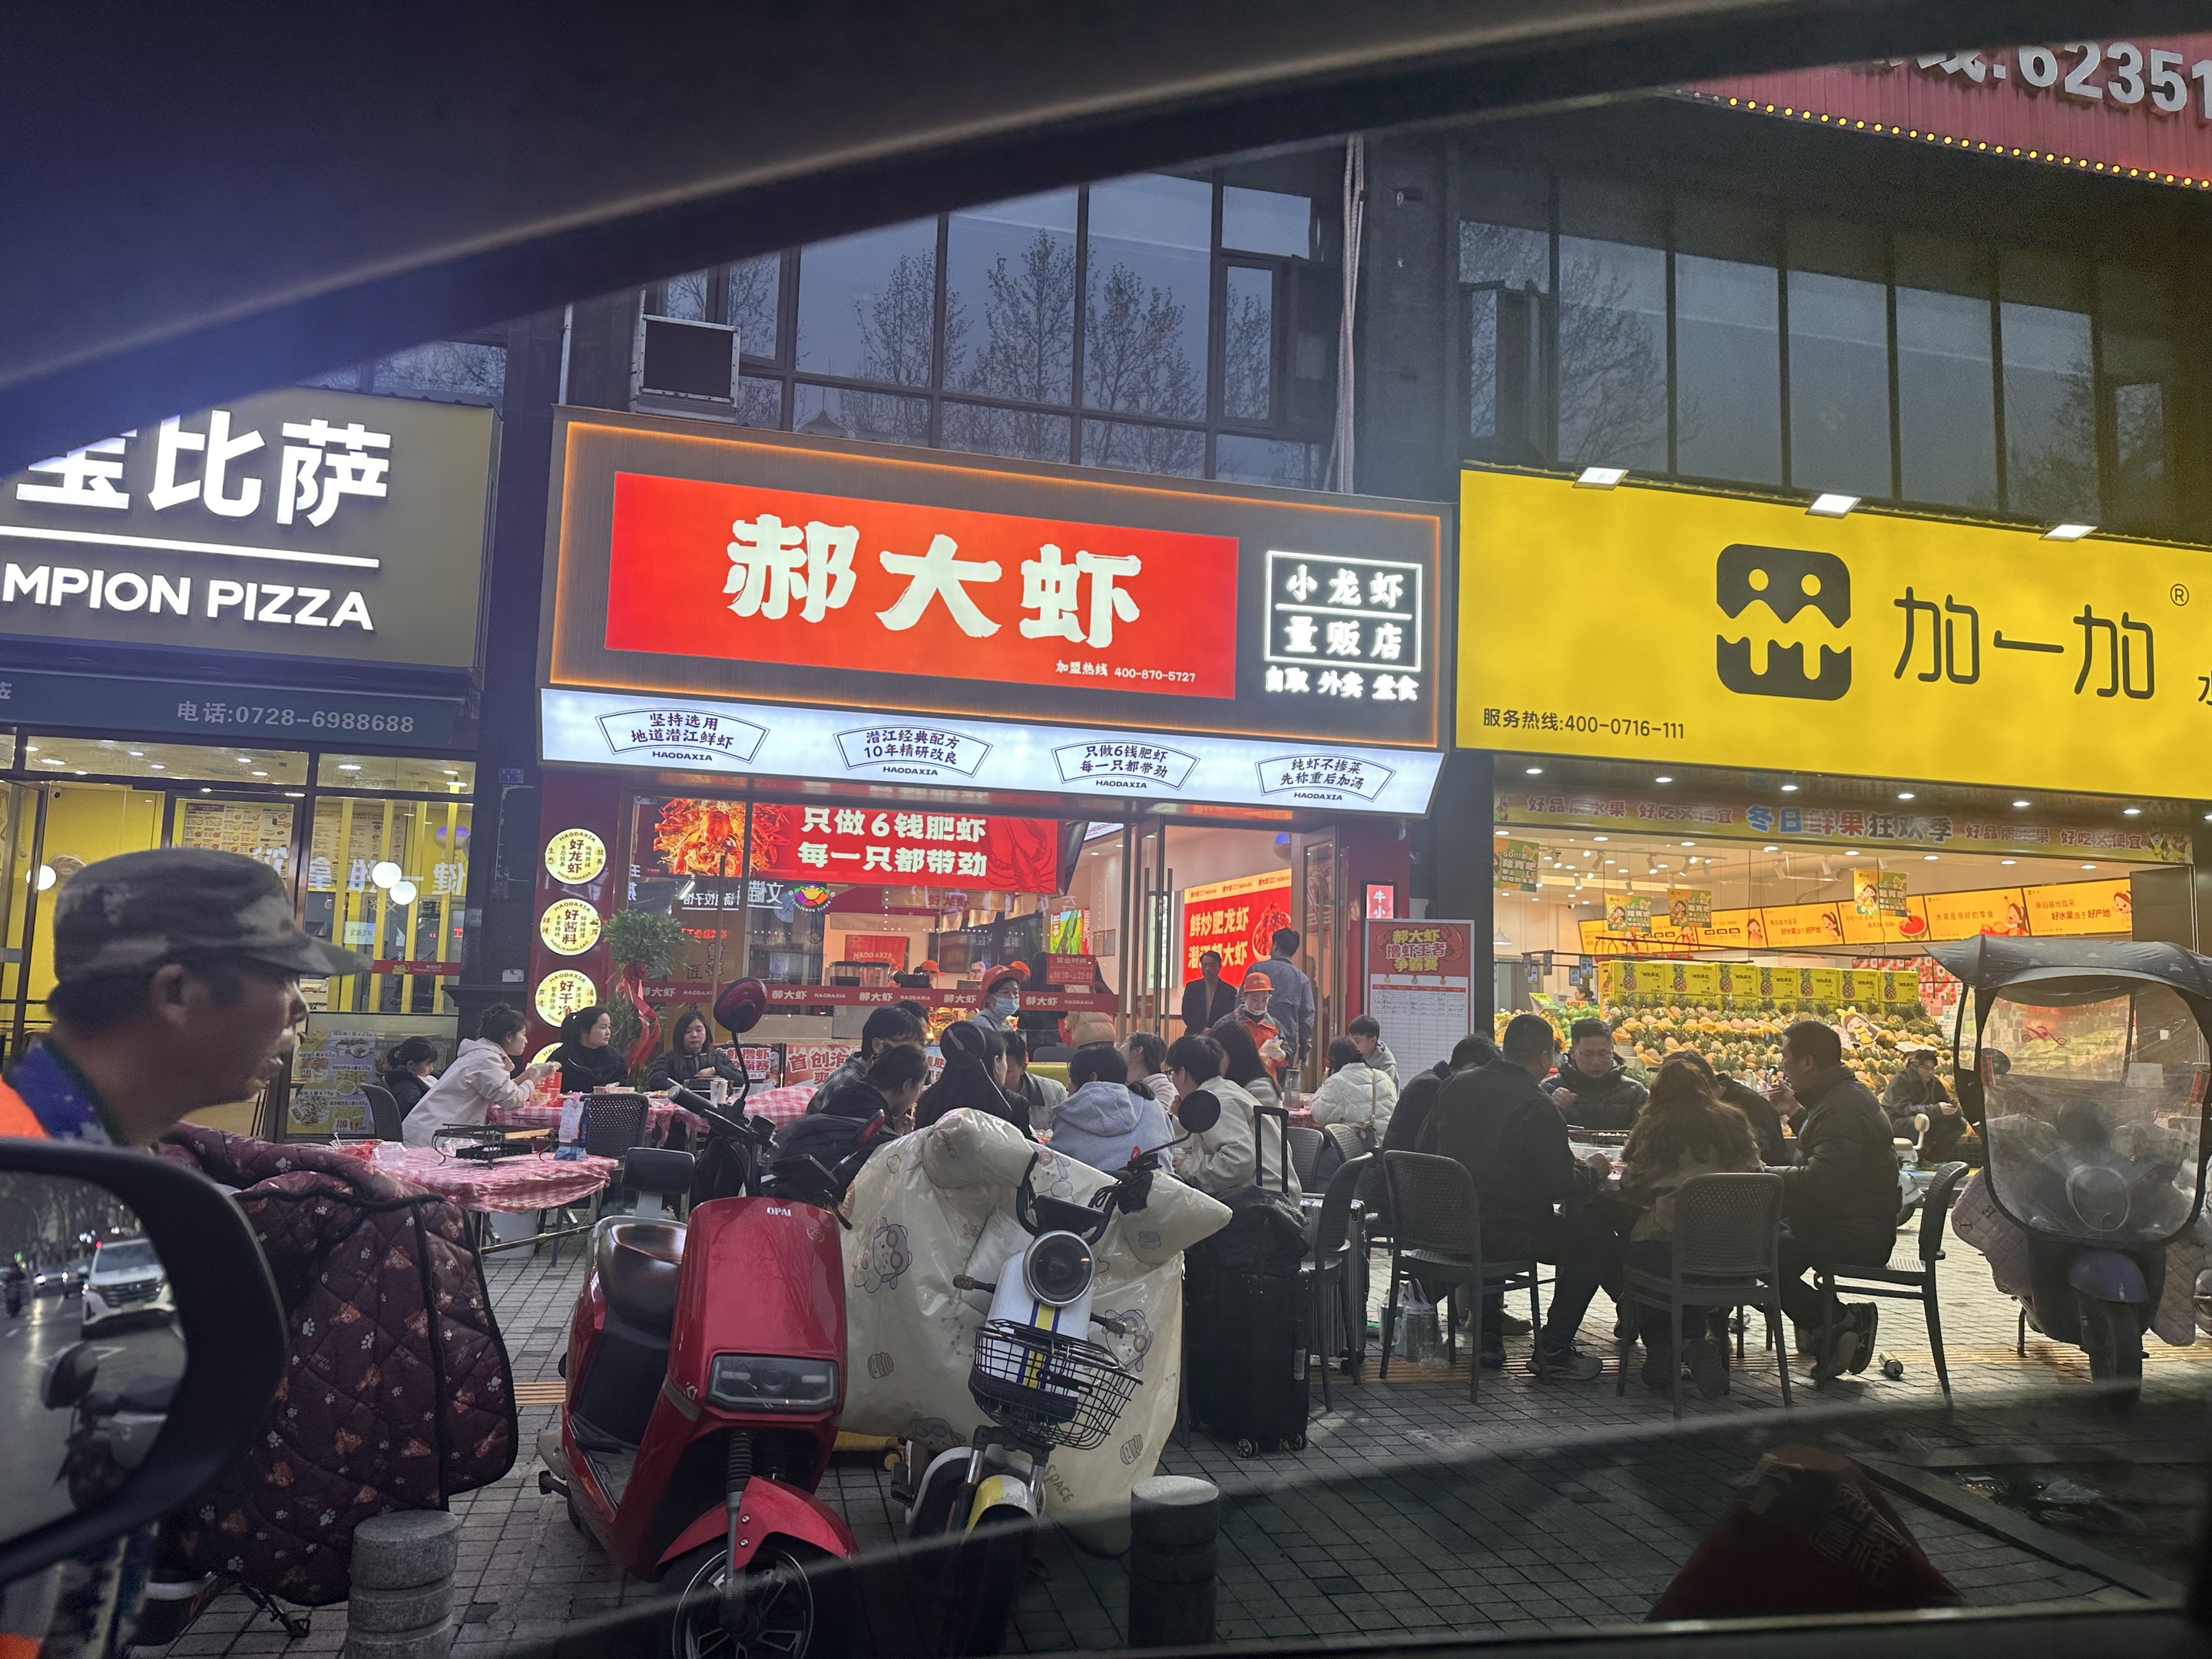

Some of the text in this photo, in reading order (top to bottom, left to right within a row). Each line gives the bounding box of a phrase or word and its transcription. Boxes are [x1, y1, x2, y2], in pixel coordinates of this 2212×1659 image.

[722, 513, 1141, 649] 郝大虾
[1286, 564, 1404, 609] 小龙虾
[2, 562, 374, 631] MPION PIZZA
[1285, 616, 1403, 661] 量贩店
[1893, 585, 2155, 700] 加一加
[1055, 659, 1196, 684] 加盟热线 400-870-5727
[1266, 665, 1310, 694] 自取
[1318, 670, 1364, 698] 外卖
[177, 700, 415, 733] 电话:0728-6988688
[649, 713, 719, 732] 坚持选用
[1482, 707, 1685, 740] 服务热线:400-0716-111
[631, 728, 735, 750] 地道潜江鲜虾
[866, 729, 960, 750] 潜江经典配方
[651, 750, 714, 762] HAODAXIA
[863, 743, 959, 767] 10年精研改良
[1084, 743, 1167, 762] 只做6钱肥虾
[882, 766, 939, 777] HAODAXIA
[1079, 759, 1167, 780] 每一只都带劲
[1290, 757, 1362, 776] 纯虾不掺菜
[1095, 779, 1147, 790] HAODAXIA
[1280, 771, 1364, 791] 先称重后加汤
[1293, 791, 1343, 801] HAODAXIA
[800, 806, 986, 843] 只做6钱肥虾
[1746, 803, 1953, 843] 冬日鲜果狂欢季
[559, 831, 596, 843] HAODAXIA
[567, 839, 584, 874] 好龙虾
[797, 841, 988, 877] 每一只都带劲
[554, 902, 591, 912] HAODAXIA
[1936, 909, 1995, 921] 水果是很好的零食
[1189, 906, 1250, 937] 鲜炒肥龙虾
[1392, 929, 1441, 943] 郝大虾
[853, 952, 892, 961] HAODAXIA
[1386, 942, 1447, 960] 撸虾王者
[1393, 957, 1439, 973] 争霸赛
[548, 972, 586, 983] HAODAXIA
[771, 989, 807, 1001] 郝大虾
[859, 991, 893, 1003] 郝大虾
[943, 993, 977, 1005] 郝大虾
[1025, 995, 1058, 1007] 郝大虾
[766, 1206, 791, 1217] OPAI
